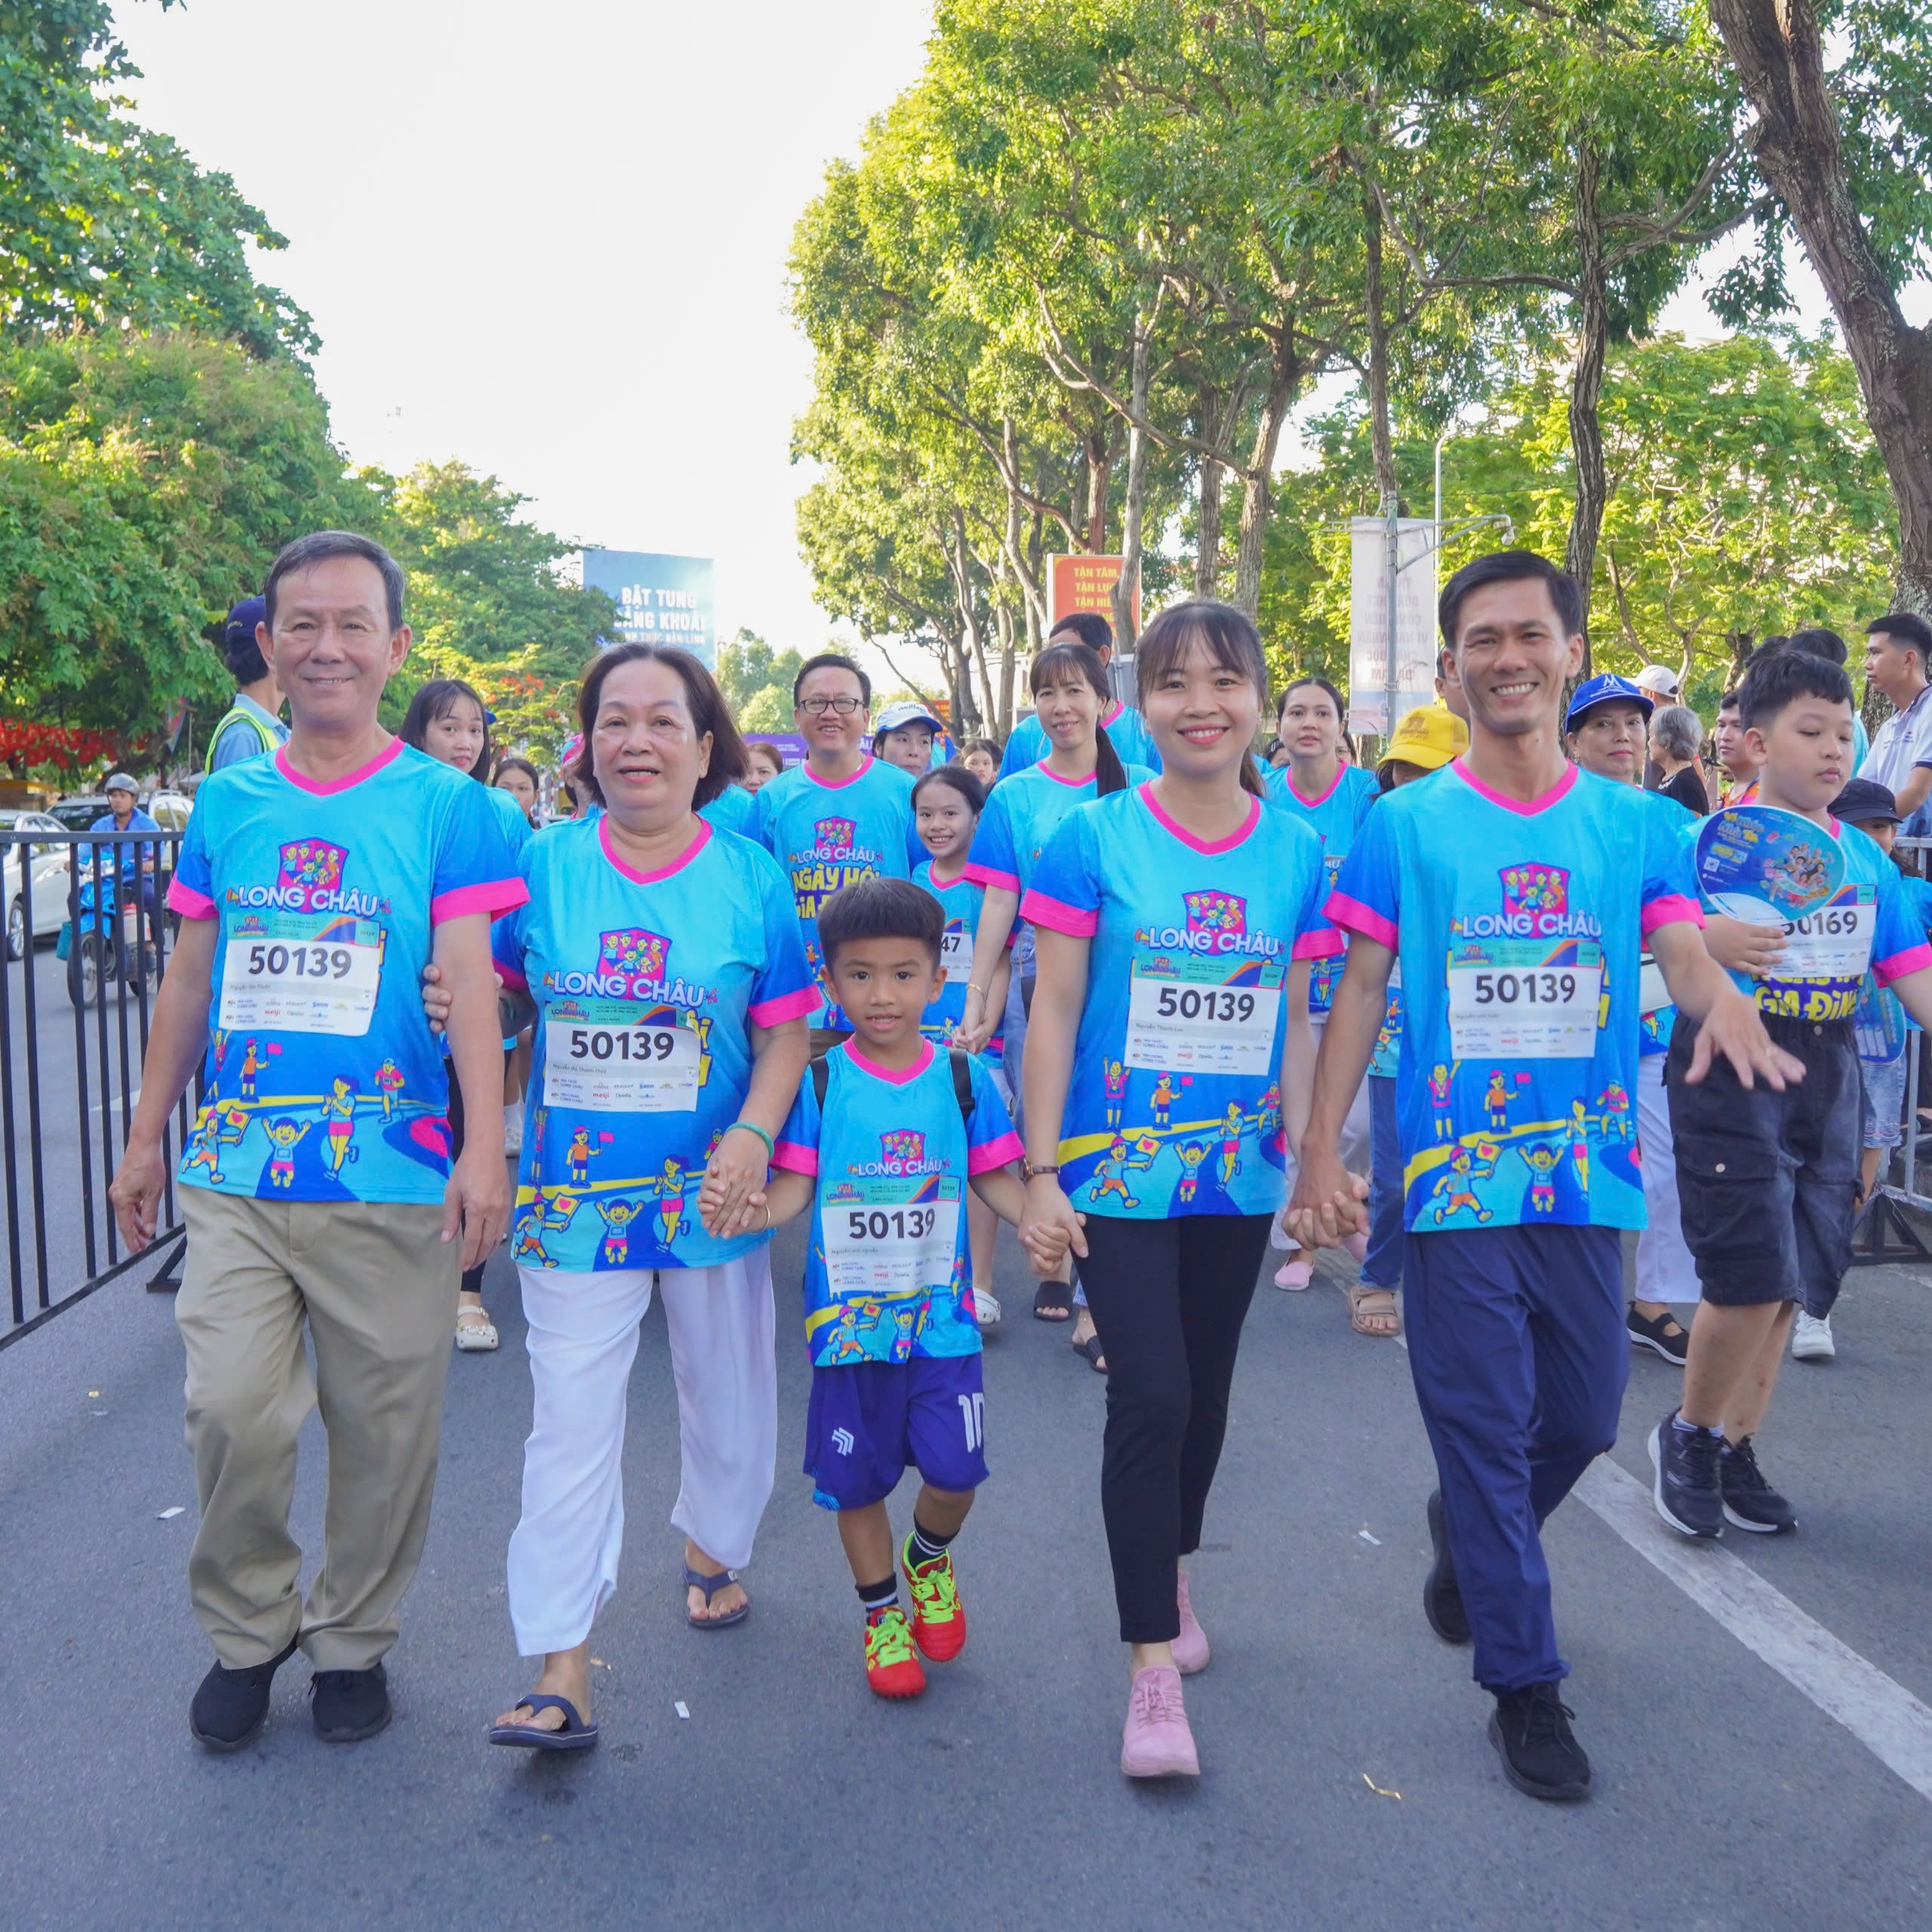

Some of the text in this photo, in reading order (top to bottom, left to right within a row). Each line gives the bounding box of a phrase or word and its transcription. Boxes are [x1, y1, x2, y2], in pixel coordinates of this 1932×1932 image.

[1074, 566, 1094, 579] TẬN
[1075, 581, 1094, 594] TẬN
[1075, 596, 1094, 608] TẬN
[796, 846, 875, 863] LONG CHÂU
[238, 885, 377, 916] LONG CHÂU
[1463, 909, 1601, 937] LONG CHÂU
[1149, 928, 1278, 955] LONG CHÂU
[248, 946, 352, 979] 50139
[555, 971, 704, 1006] LONG CHÂU
[1475, 974, 1576, 1004] 50139
[1157, 988, 1254, 1022] 50139
[570, 1030, 674, 1060] 50139
[858, 1158, 943, 1175] LONG CHÂU
[849, 1208, 935, 1238] 50139
